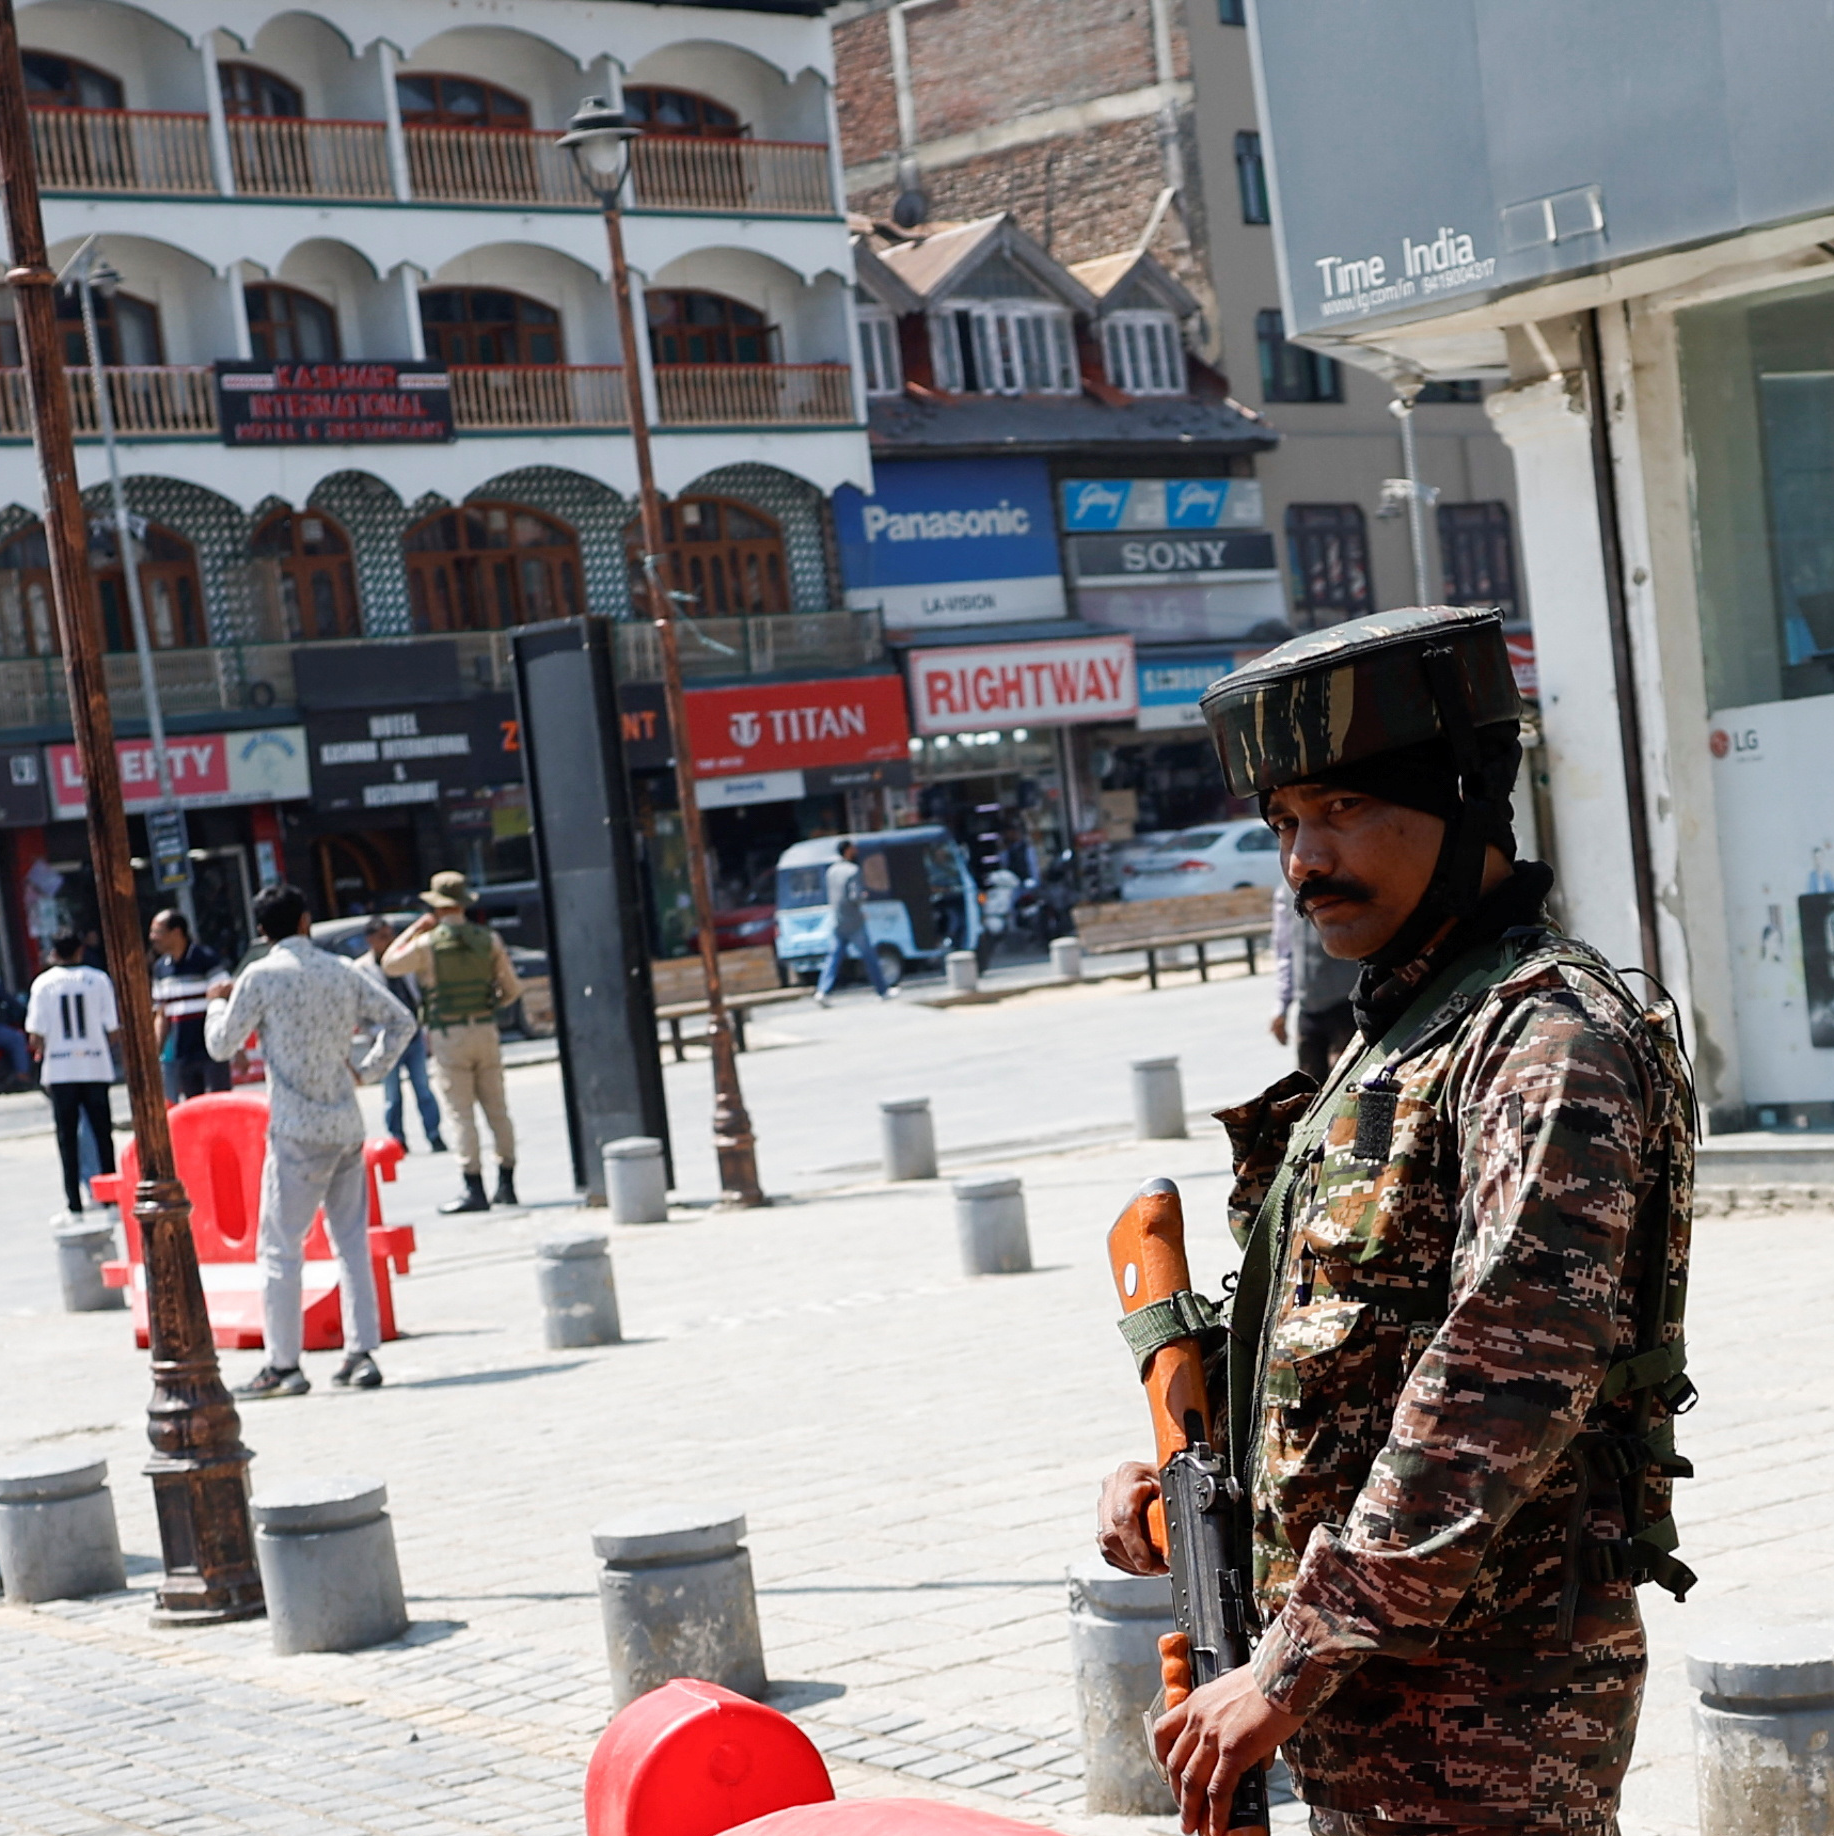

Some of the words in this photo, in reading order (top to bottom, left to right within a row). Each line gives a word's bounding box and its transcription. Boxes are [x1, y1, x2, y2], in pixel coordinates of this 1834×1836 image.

[1315, 255, 1386, 298] Time
[1402, 226, 1476, 278] India
[273, 364, 398, 389] KASHMIR
[862, 500, 1031, 543] Panasonic
[1121, 540, 1229, 571] SONY
[925, 656, 1127, 717] RIGHTWAY
[767, 703, 867, 745] TITAN
[1734, 729, 1759, 752] LG
[60, 744, 215, 789] LETY
[61, 992, 86, 1041] 11
